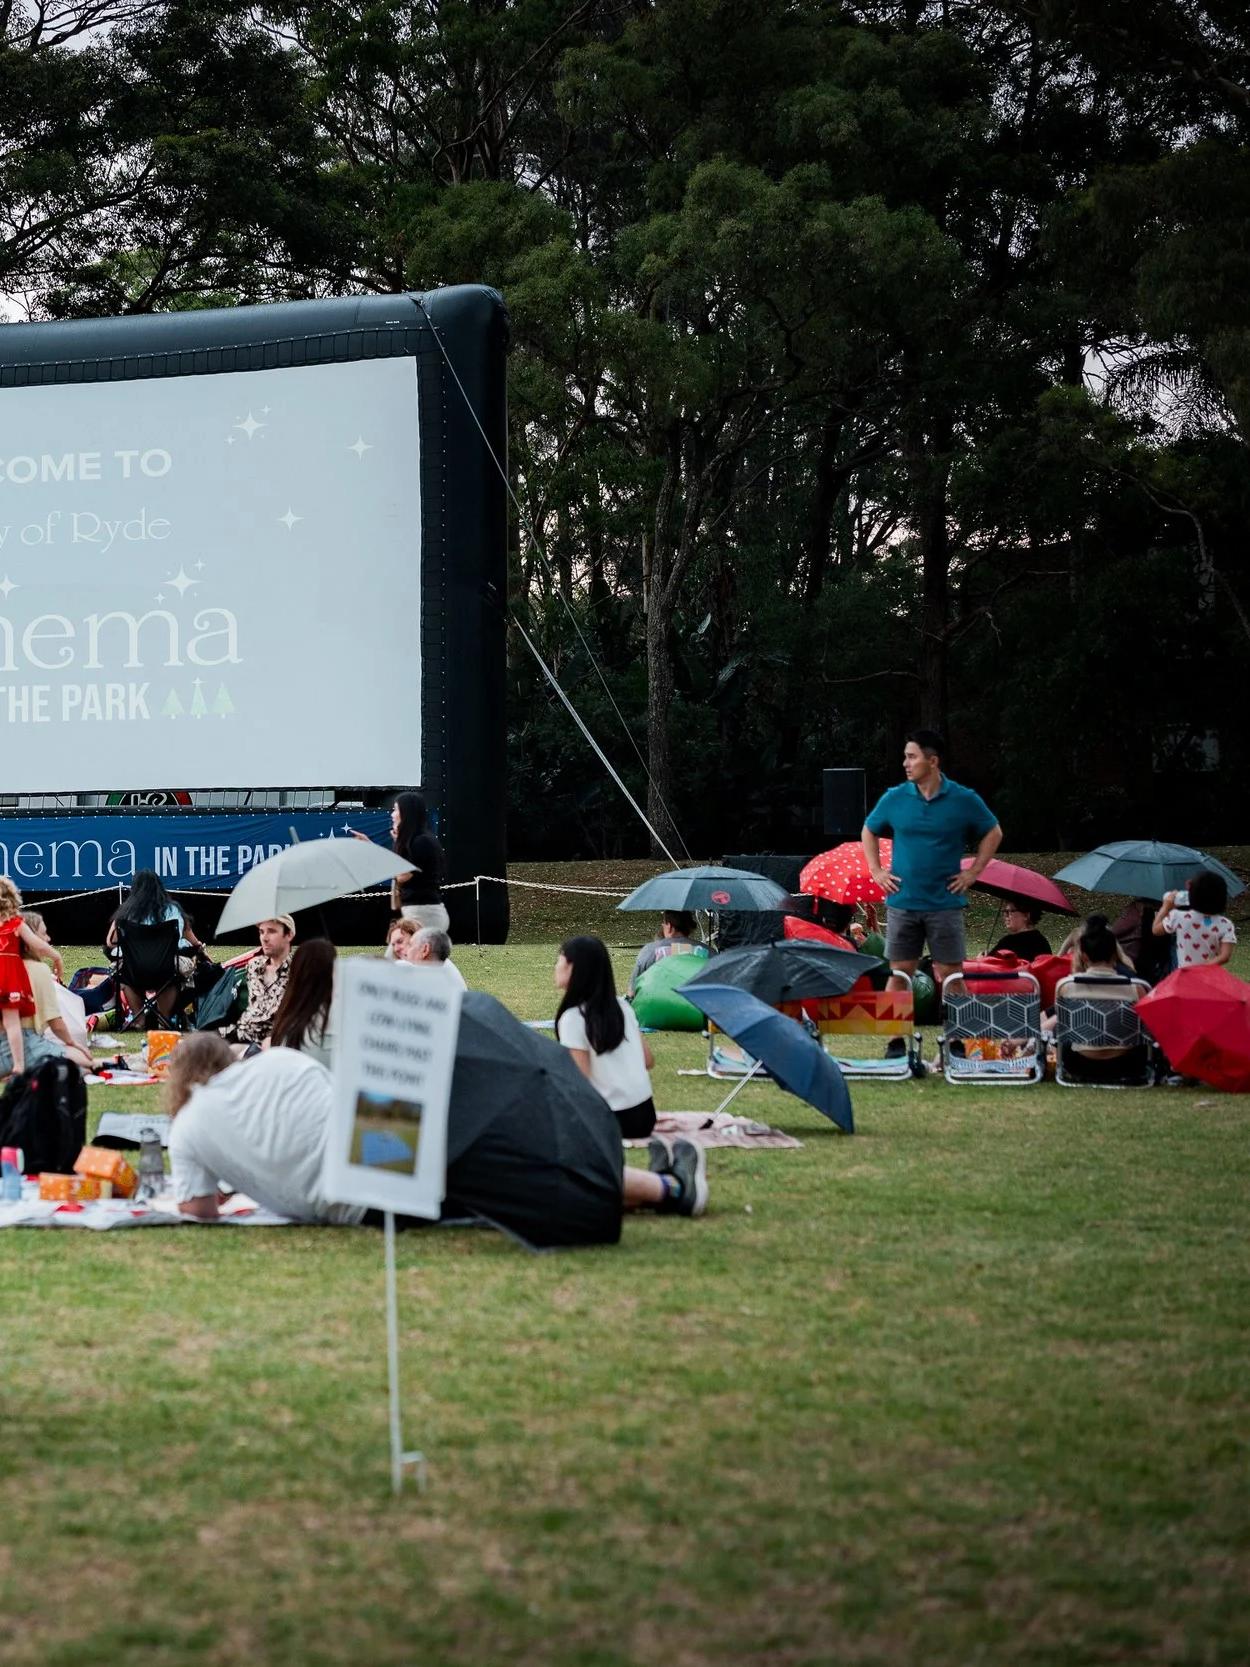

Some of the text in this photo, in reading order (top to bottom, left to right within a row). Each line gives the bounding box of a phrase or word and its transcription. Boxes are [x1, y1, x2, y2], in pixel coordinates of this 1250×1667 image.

[114, 448, 172, 478] TO
[20, 510, 61, 546] of
[70, 506, 171, 553] Ryde
[62, 682, 151, 721] PARK
[154, 846, 178, 877] IN
[185, 845, 230, 876] THE
